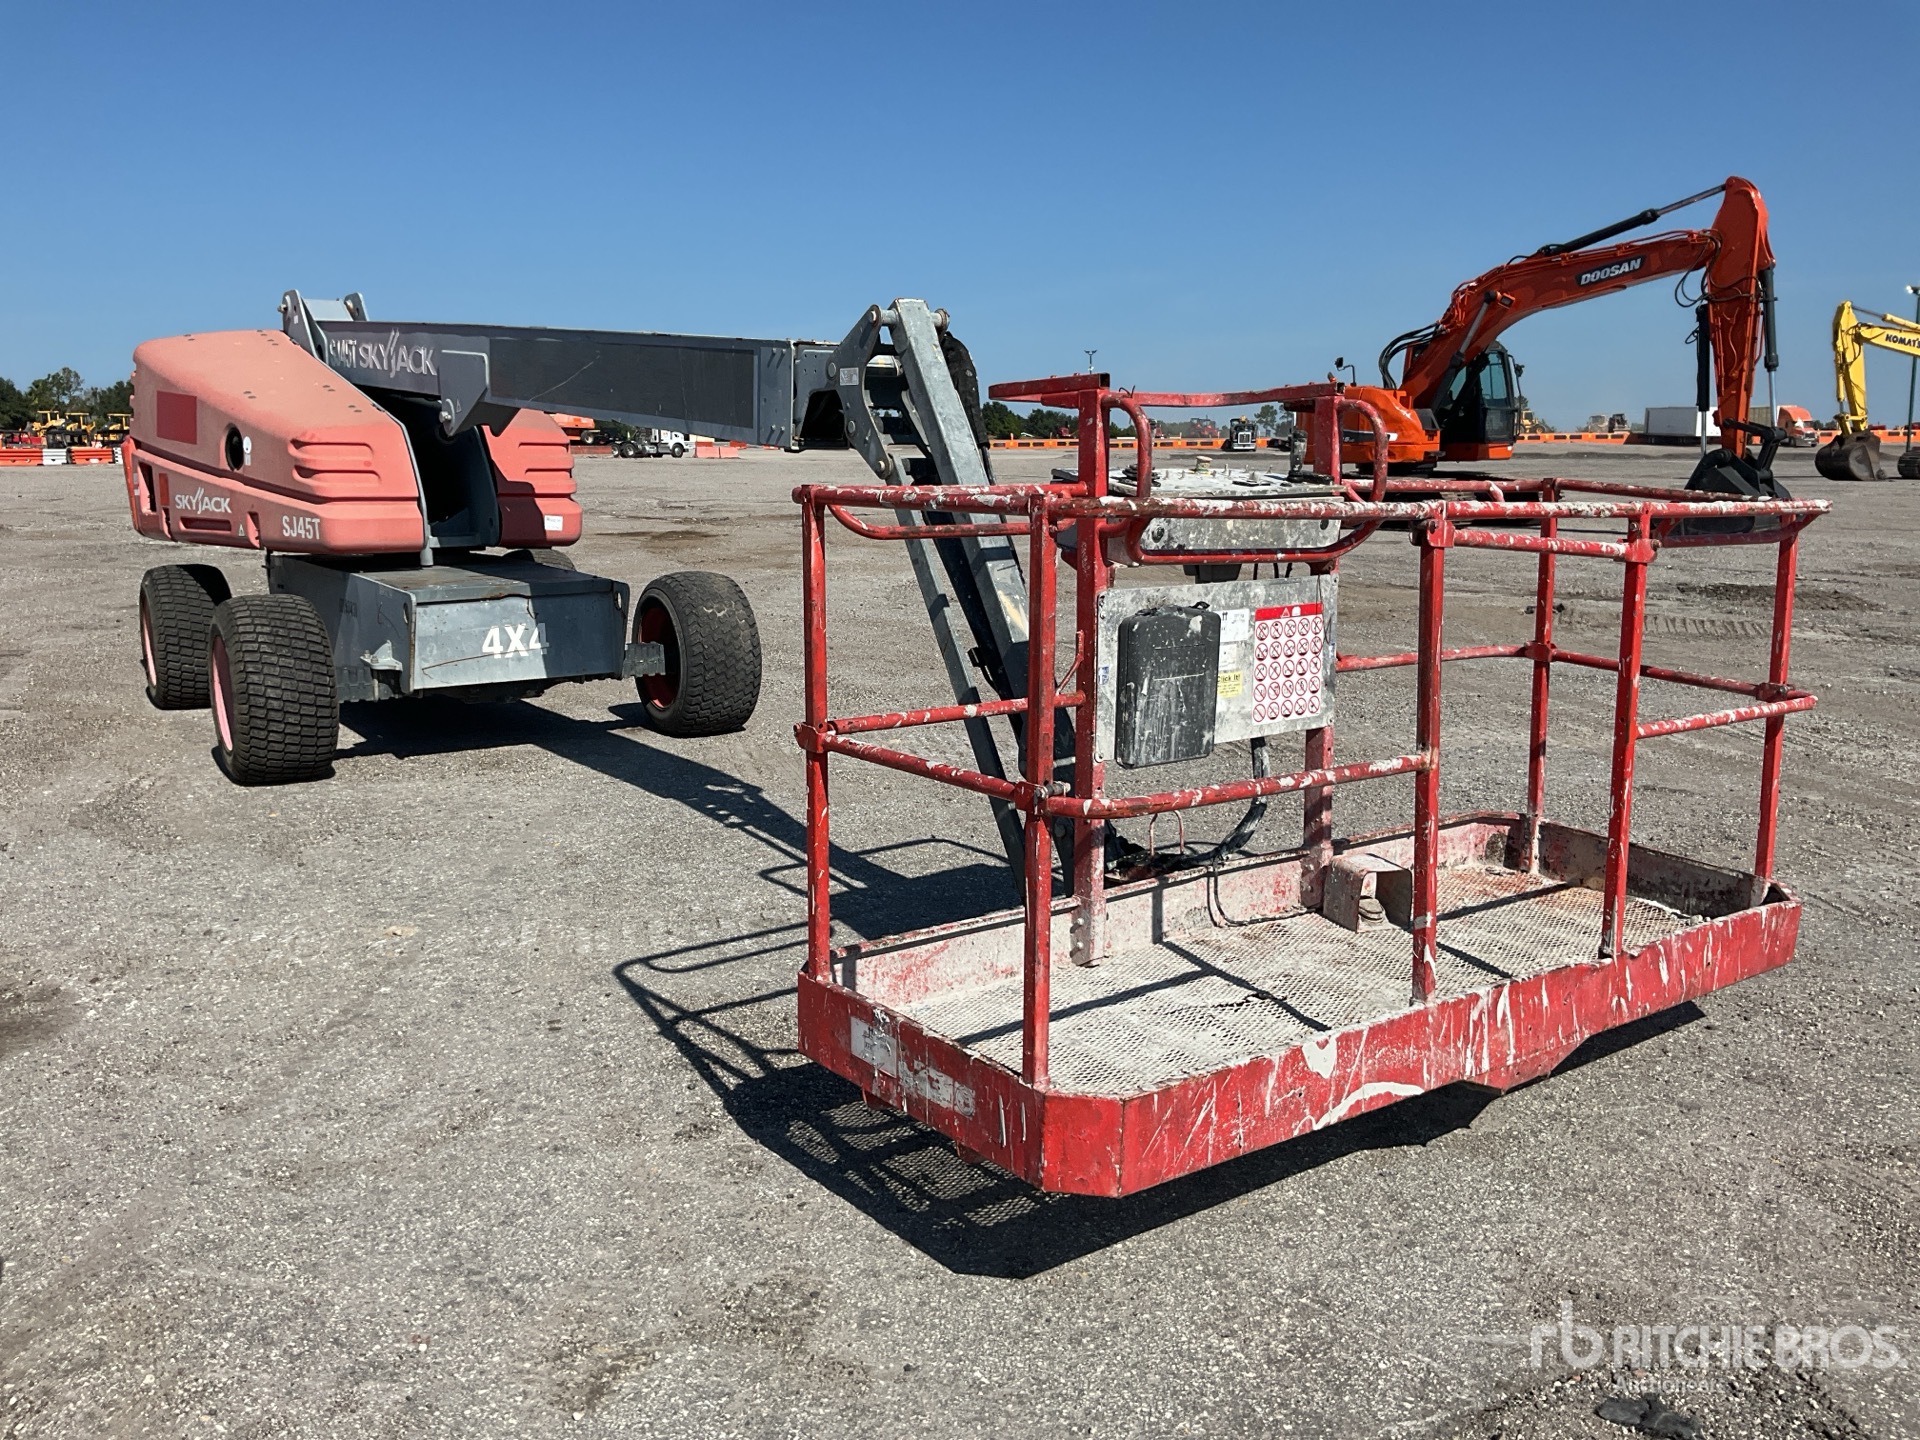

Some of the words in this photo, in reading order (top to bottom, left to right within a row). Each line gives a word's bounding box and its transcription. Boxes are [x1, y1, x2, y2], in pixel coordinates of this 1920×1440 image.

[1580, 258, 1642, 285] DOOSAN
[358, 328, 437, 378] SKYJACK
[175, 486, 232, 515] SKYJACK
[282, 515, 321, 540] SJ45T
[482, 622, 550, 659] 4X4
